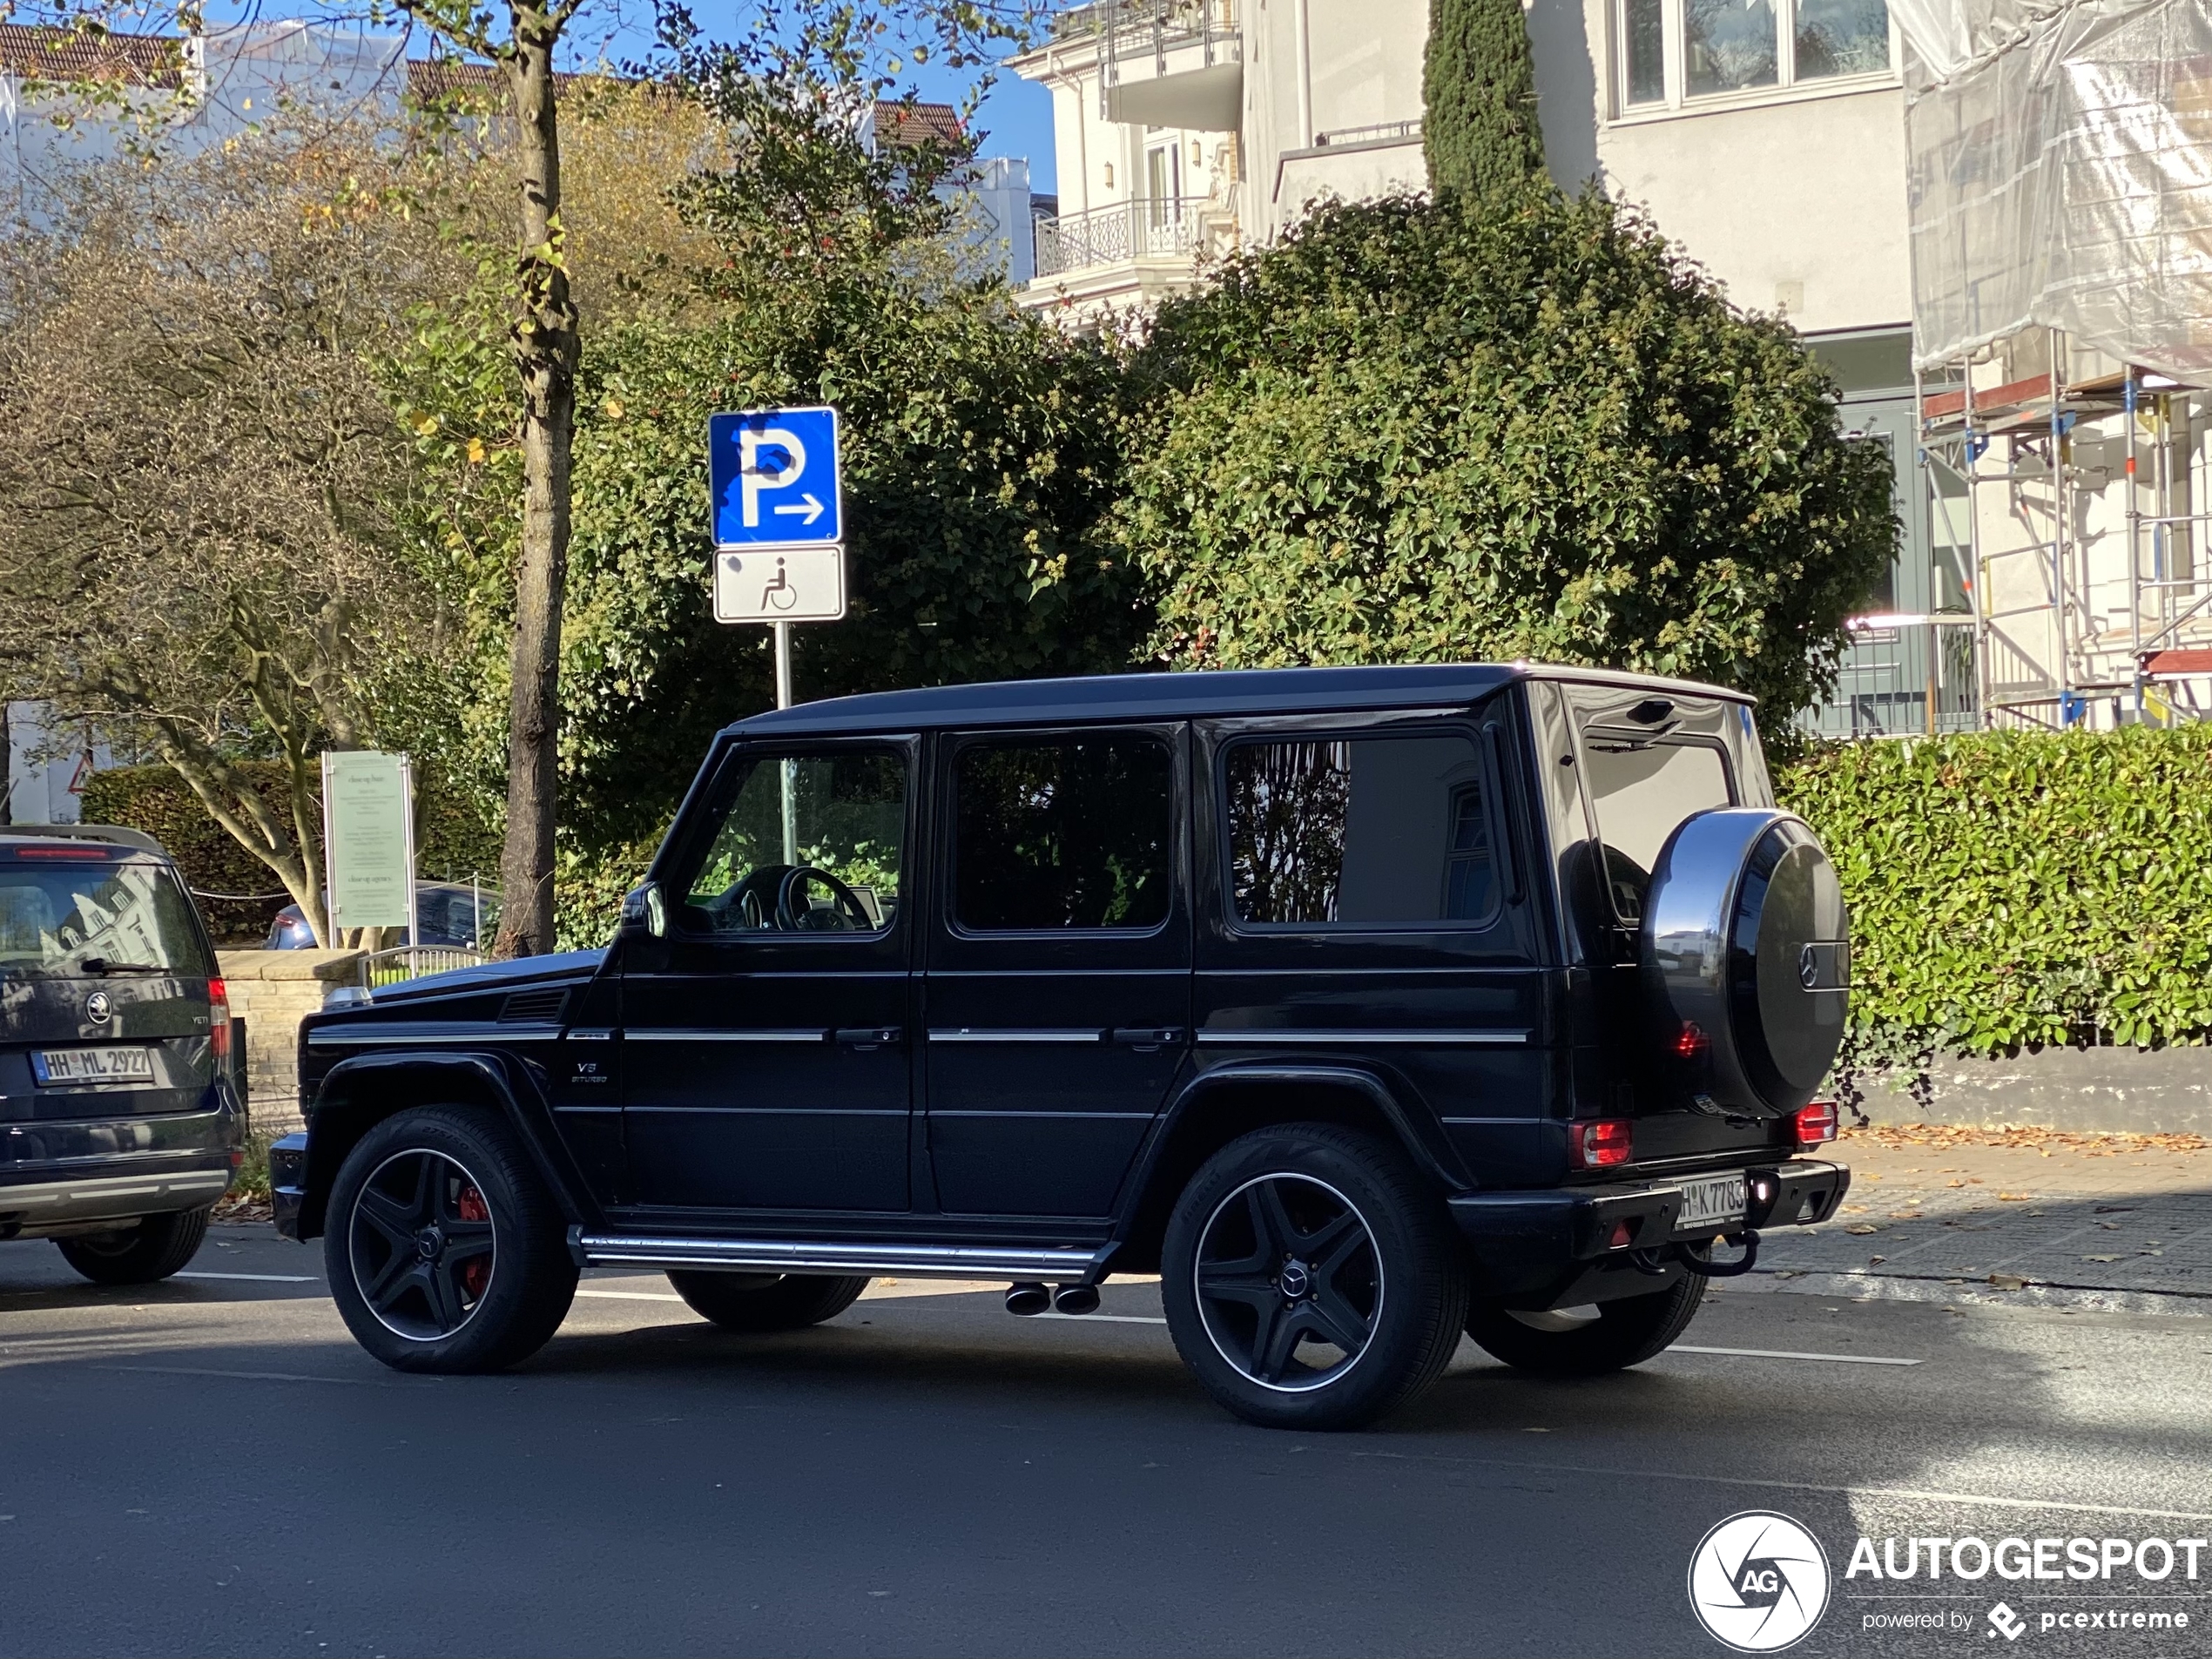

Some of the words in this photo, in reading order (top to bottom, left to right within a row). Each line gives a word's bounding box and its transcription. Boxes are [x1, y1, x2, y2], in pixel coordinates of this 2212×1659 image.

[740, 428, 806, 527] P
[192, 1016, 208, 1025] YETI
[45, 1053, 71, 1077] HH
[80, 1051, 107, 1075] ML
[107, 1050, 147, 1073] 2927
[577, 1063, 597, 1073] V8
[422, 1126, 470, 1150] 275/50
[1699, 1184, 1709, 1215] K
[1710, 1179, 1743, 1213] 7783
